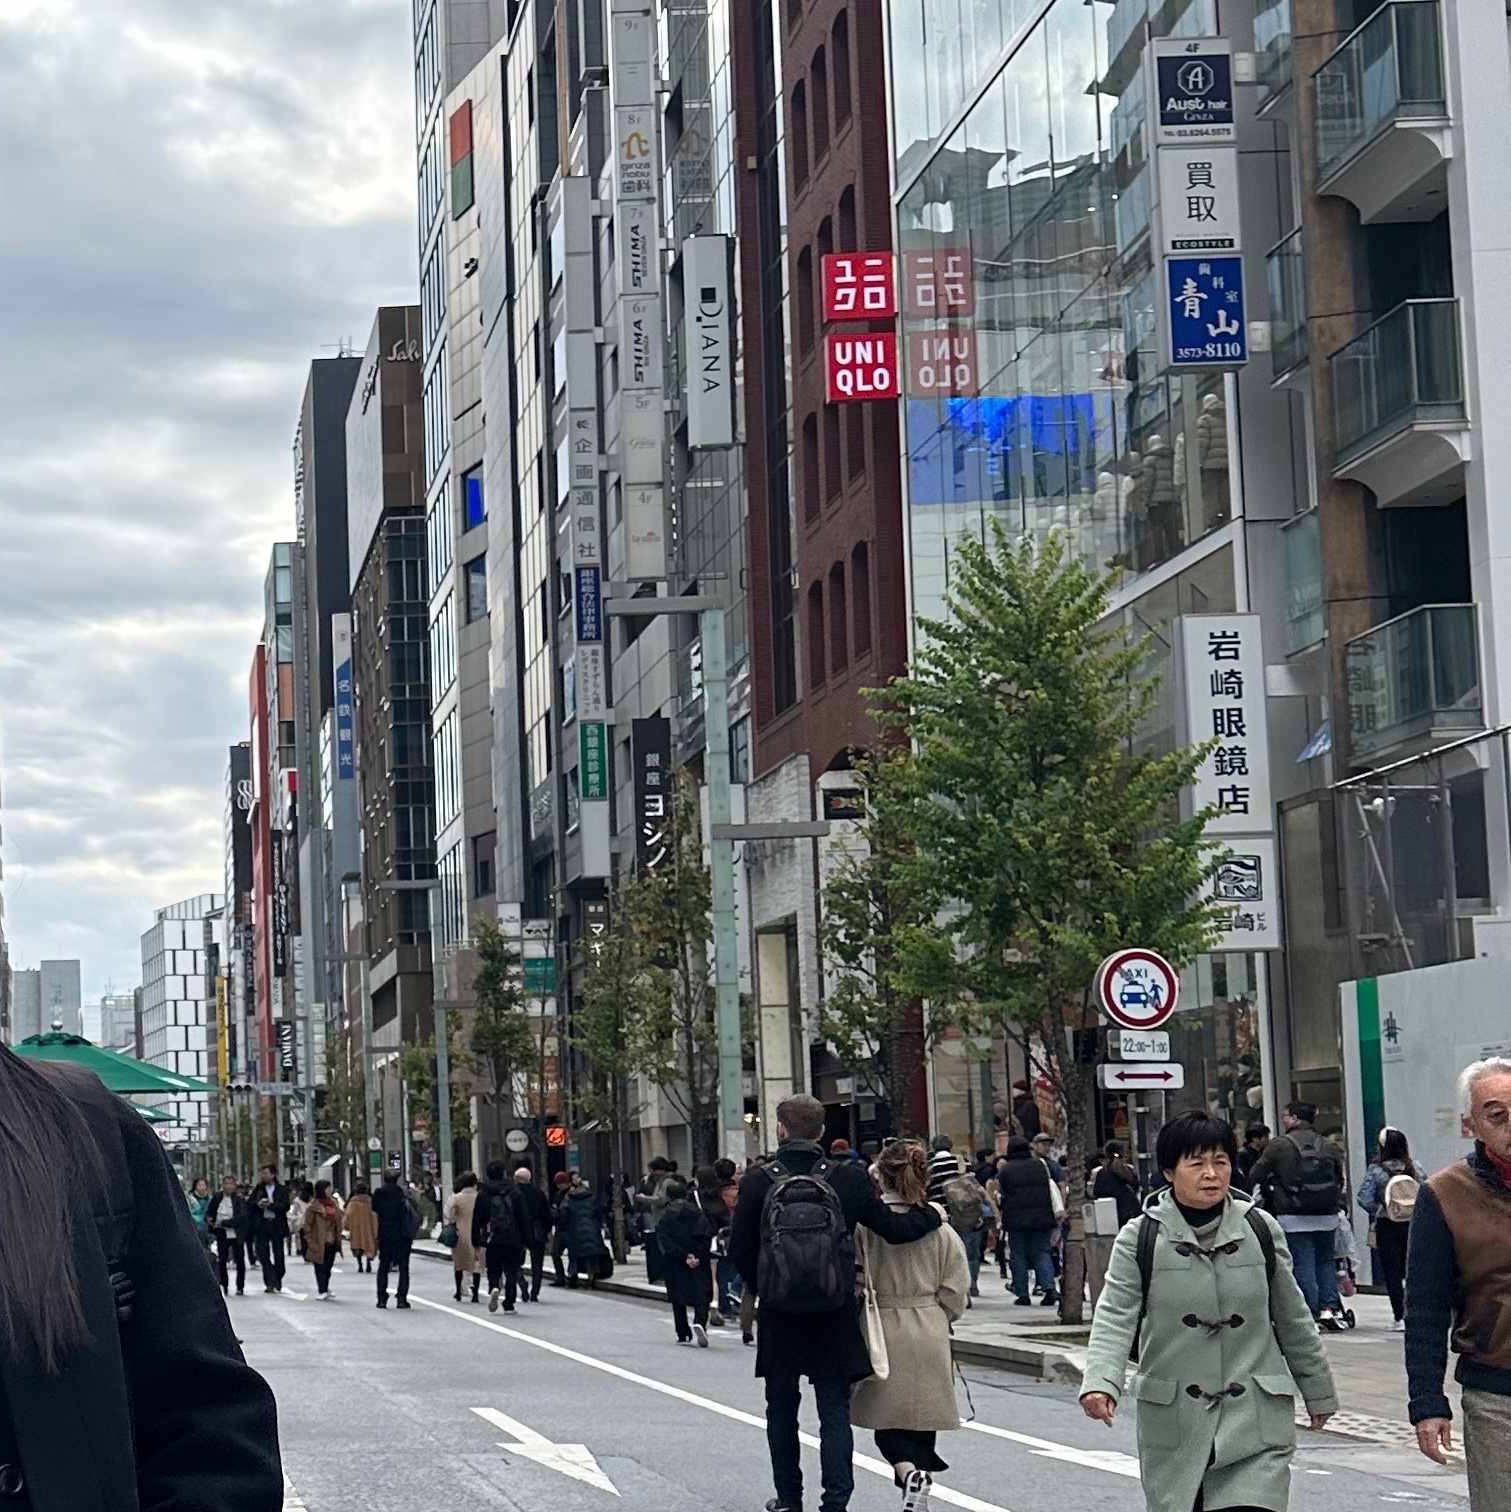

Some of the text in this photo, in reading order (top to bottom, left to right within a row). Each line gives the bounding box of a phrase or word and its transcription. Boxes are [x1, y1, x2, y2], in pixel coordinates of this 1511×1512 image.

[1185, 43, 1200, 53] 4F
[1167, 97, 1227, 111] Aust hair
[621, 163, 650, 172] ginza
[1186, 162, 1217, 222] 買取
[631, 224, 642, 288] SHIMA
[1176, 241, 1230, 249] ECOSTYLE
[1174, 277, 1239, 337] 青山
[633, 320, 644, 383] SHIMA
[697, 300, 724, 393] DIANA
[835, 341, 884, 365] UNI
[1177, 342, 1241, 358] 3573-8110
[836, 367, 890, 396] QLO
[575, 438, 596, 558] 企画通信社
[338, 680, 352, 766] 名鉄観光
[1208, 631, 1250, 815] 岩崎眼鏡店
